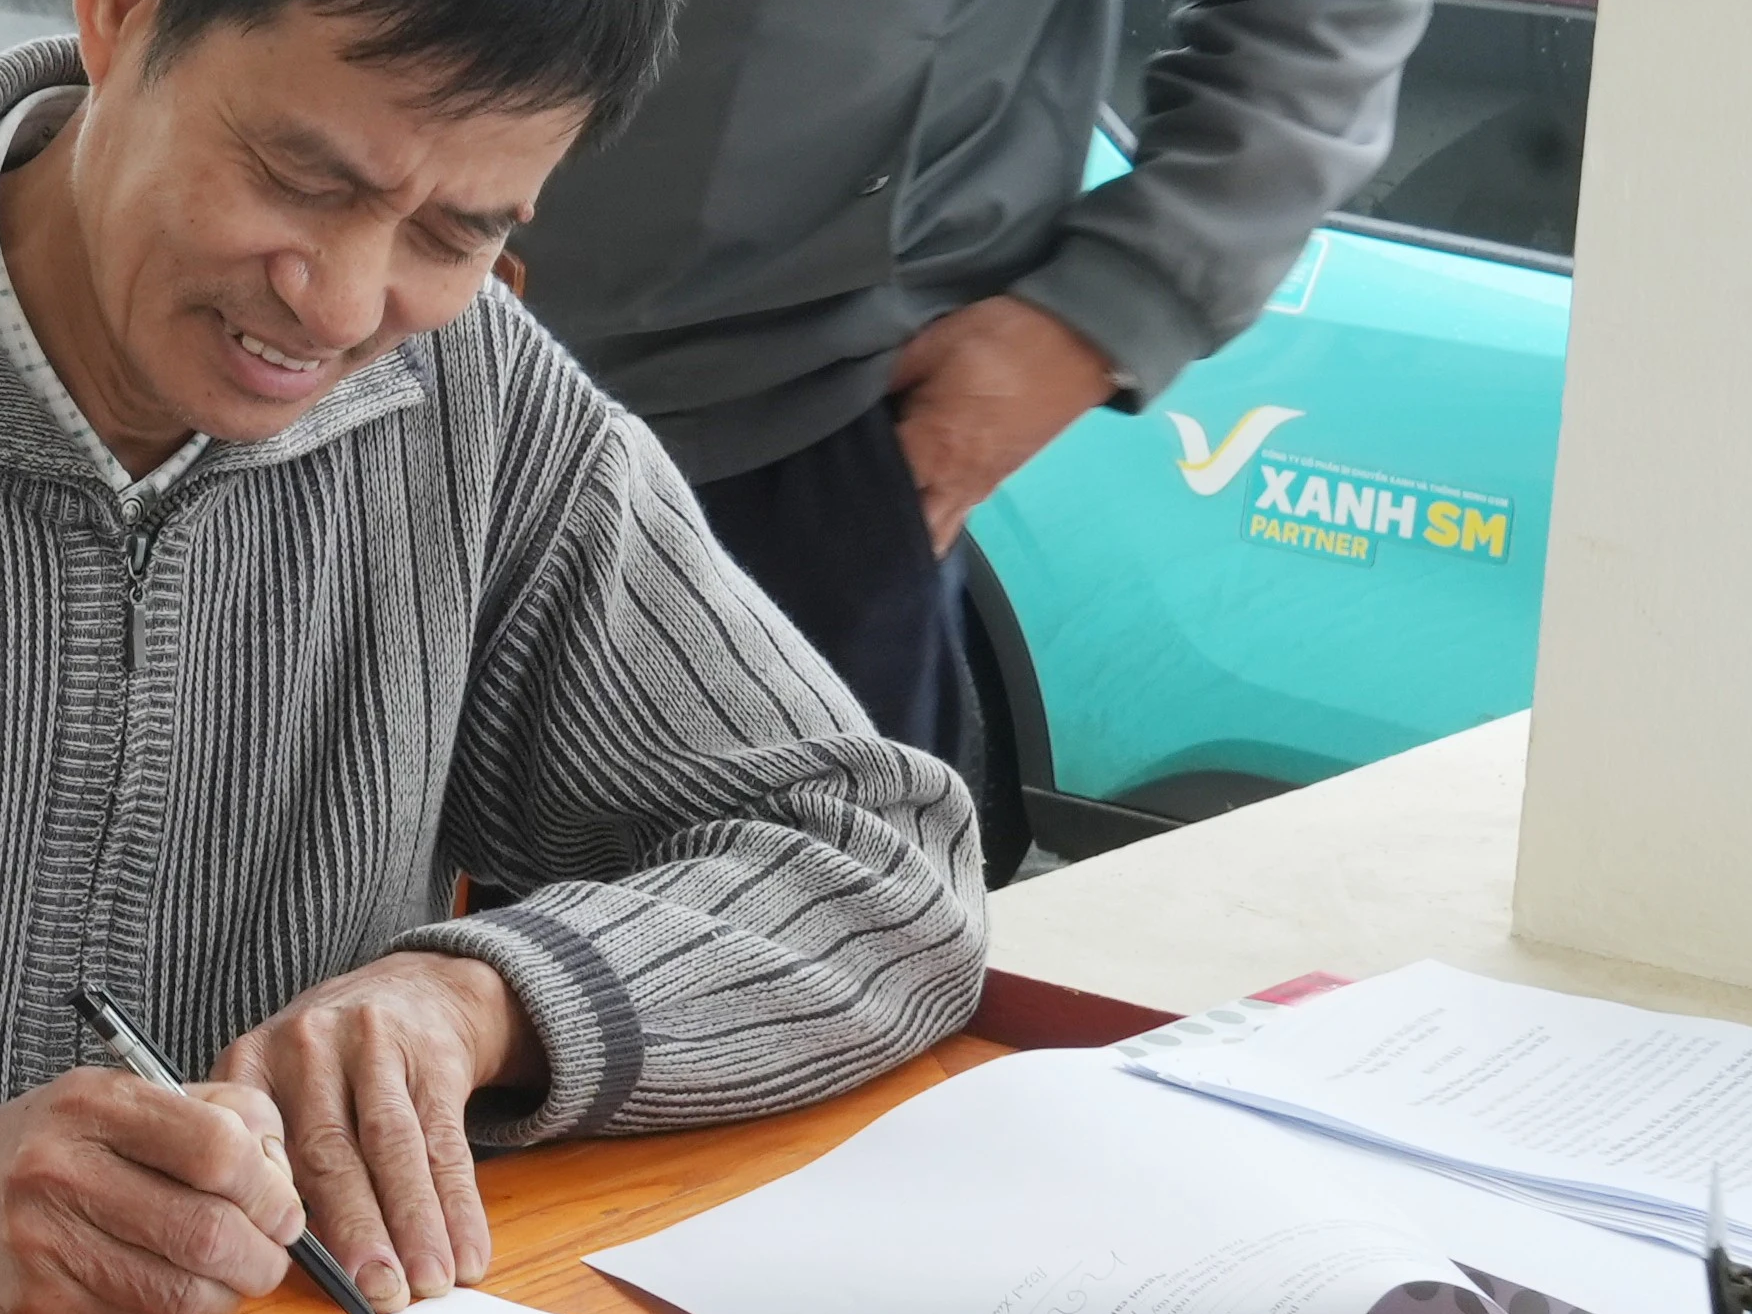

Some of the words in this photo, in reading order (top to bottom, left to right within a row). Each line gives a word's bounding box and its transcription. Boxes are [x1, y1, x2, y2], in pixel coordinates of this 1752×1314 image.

[1250, 514, 1370, 560] PARTNER
[1254, 464, 1417, 539] XANH
[1423, 500, 1507, 558] SM
